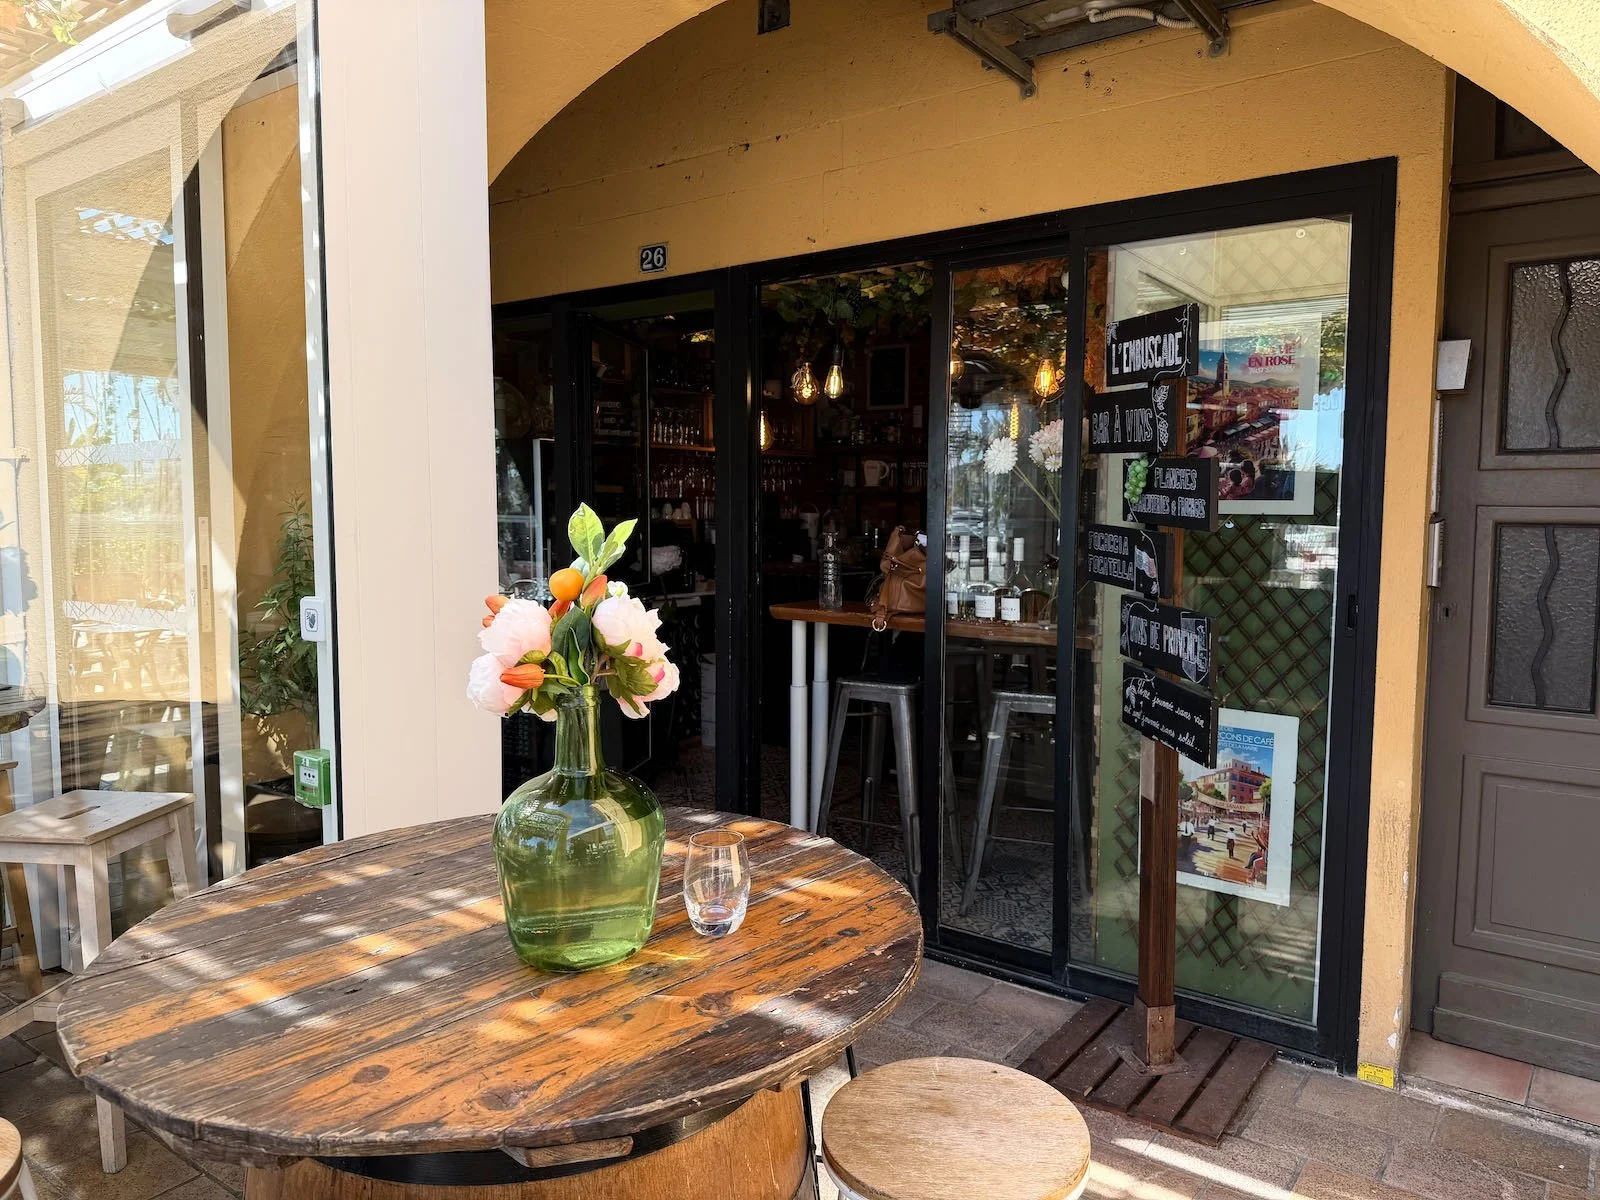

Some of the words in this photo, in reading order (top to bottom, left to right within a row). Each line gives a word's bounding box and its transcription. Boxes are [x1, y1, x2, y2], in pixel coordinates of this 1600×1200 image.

[642, 247, 664, 270] 26
[1111, 331, 1183, 375] L'EMBUSCADE
[1247, 357, 1263, 368] EN
[1265, 355, 1296, 367] ROSE
[1092, 411, 1110, 444] BAR
[1125, 407, 1153, 442] VINS
[1154, 467, 1197, 491] PLANCHES
[1088, 554, 1135, 582] FOCATELLA
[1129, 615, 1148, 646] VINS
[1149, 621, 1161, 651] DE
[1175, 707, 1192, 721] sans
[1242, 735, 1253, 744] DE
